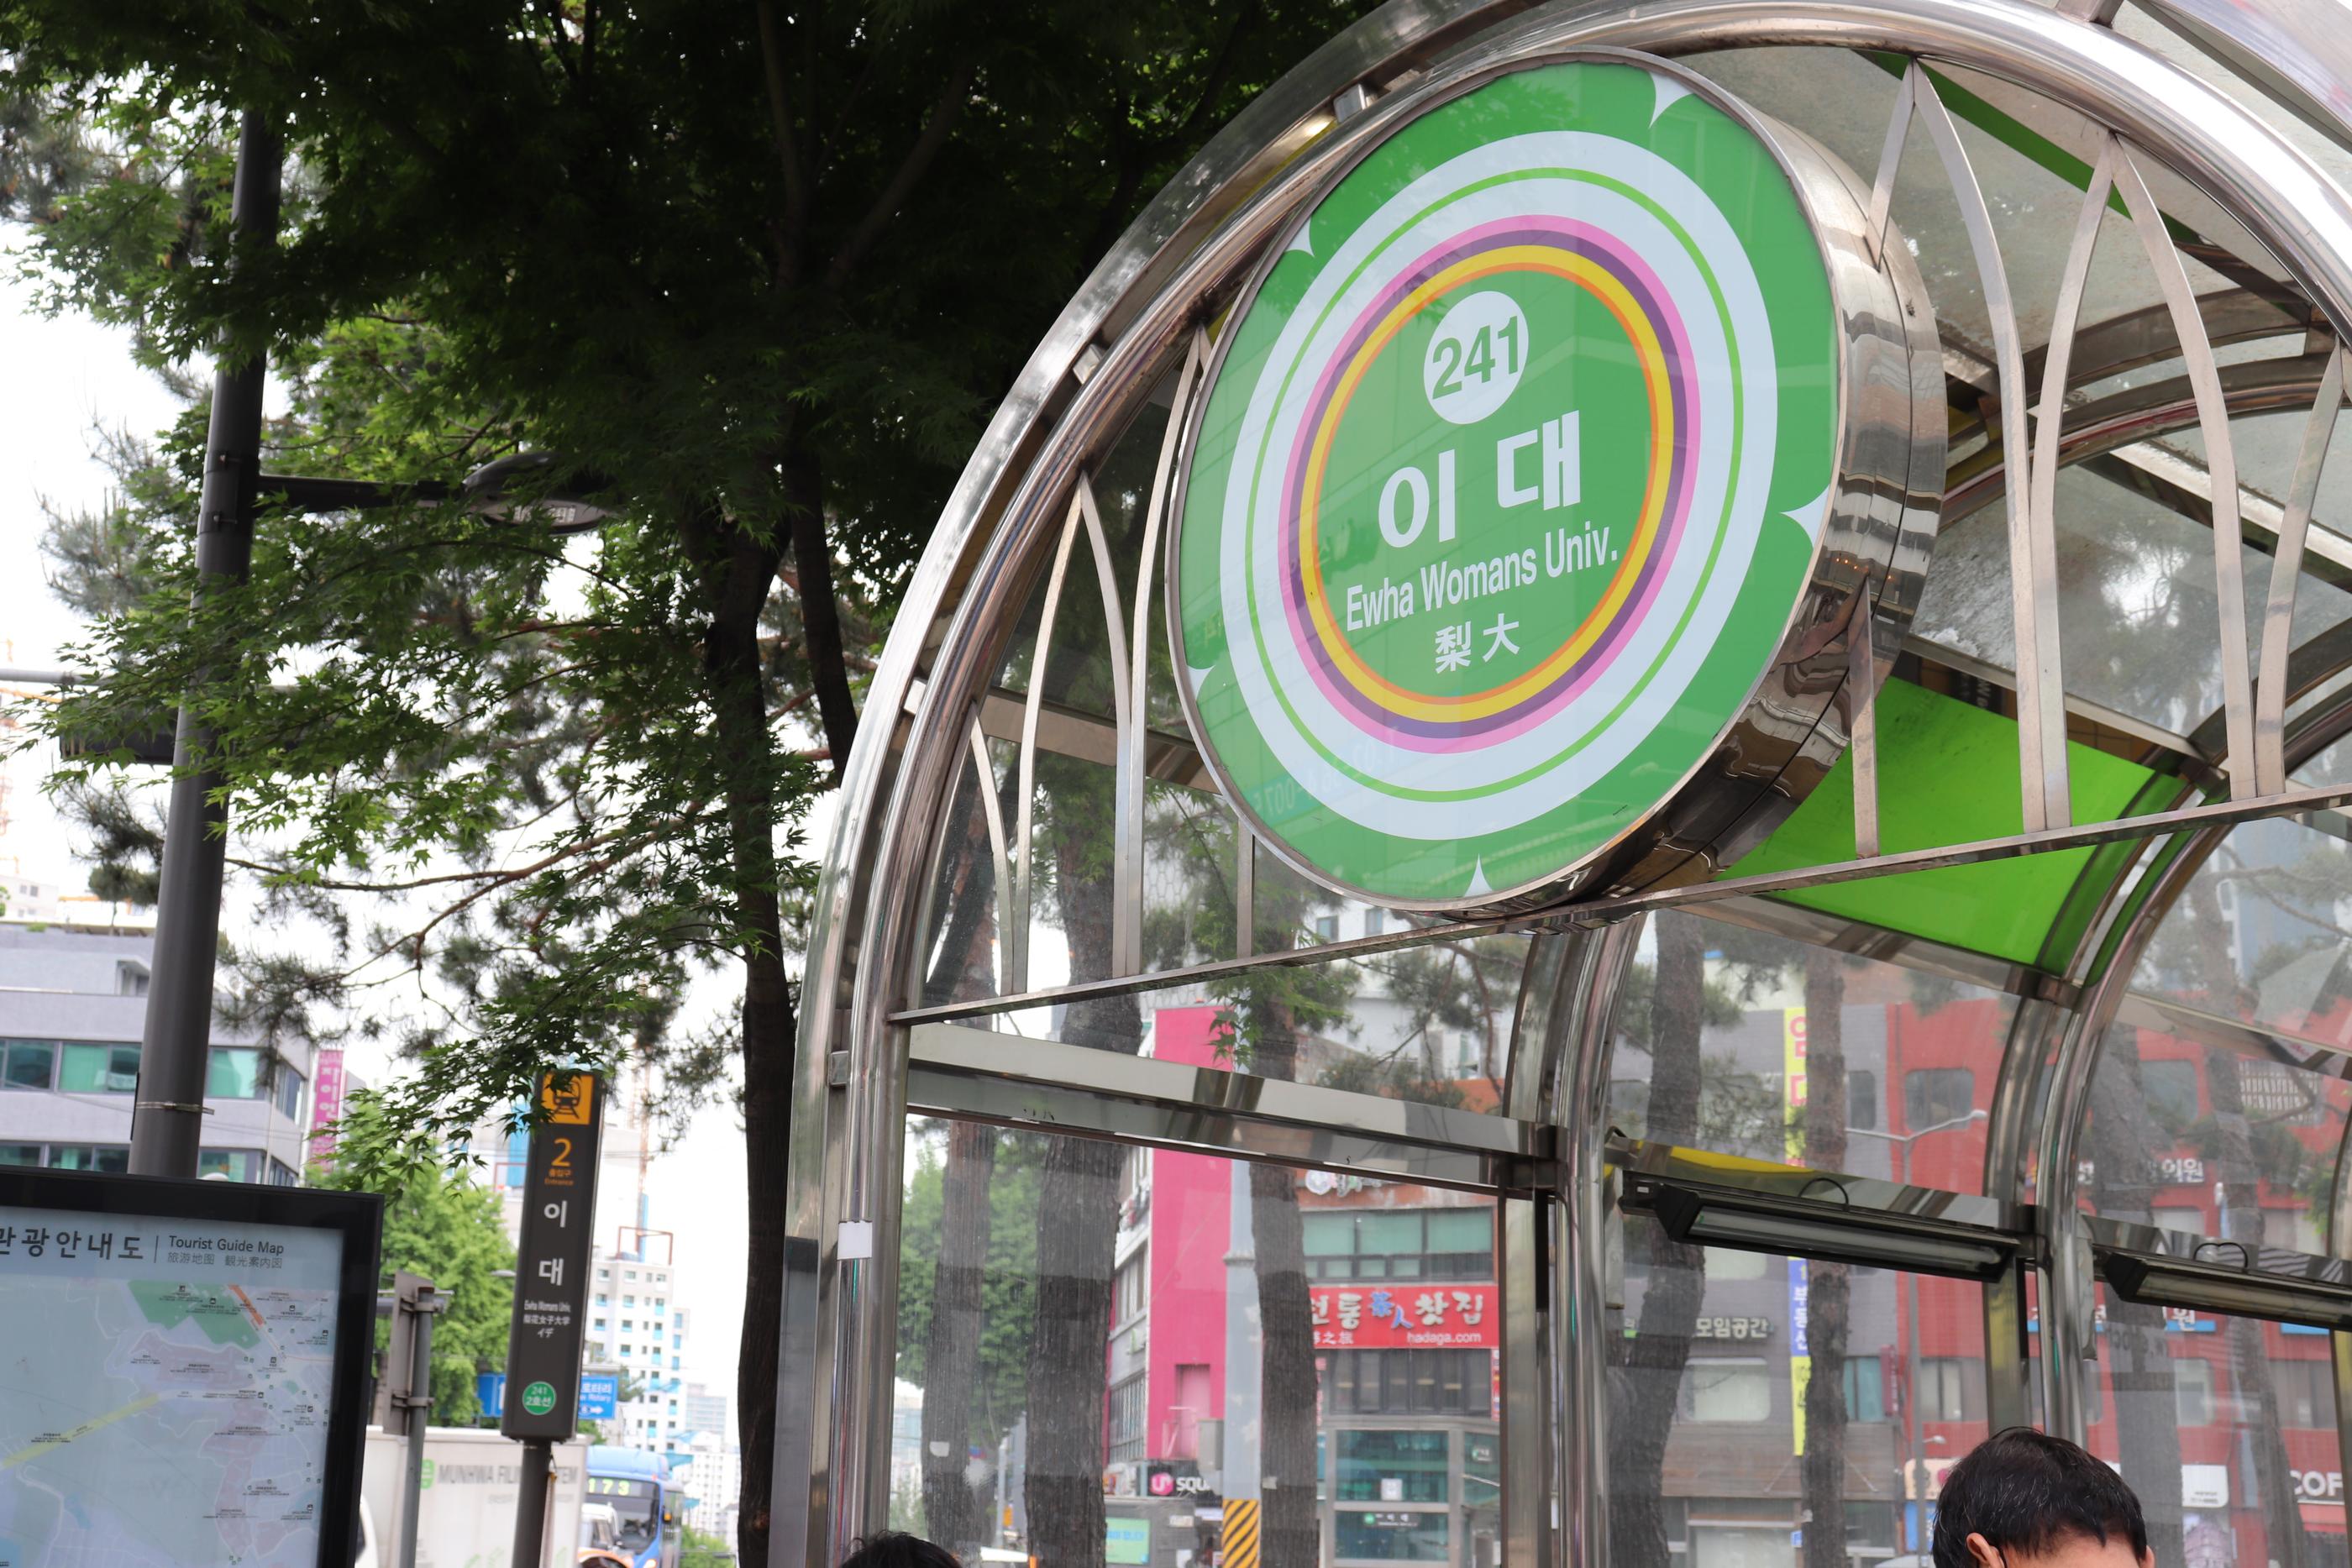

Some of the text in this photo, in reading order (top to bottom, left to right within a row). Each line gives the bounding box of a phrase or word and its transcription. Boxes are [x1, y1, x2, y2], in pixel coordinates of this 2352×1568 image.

[1431, 315, 1519, 401] 241
[1347, 521, 1618, 632] Ewha Womans Univ.
[1435, 613, 1520, 674] 梨大
[551, 1138, 572, 1167] 2
[168, 1235, 285, 1256] Tourist Guide Map
[1407, 1332, 1482, 1346] hadaga.com
[1695, 1318, 1769, 1339] 모임공간
[530, 1386, 548, 1395] 241
[524, 1396, 552, 1408] 2호선
[588, 1478, 630, 1496] 173
